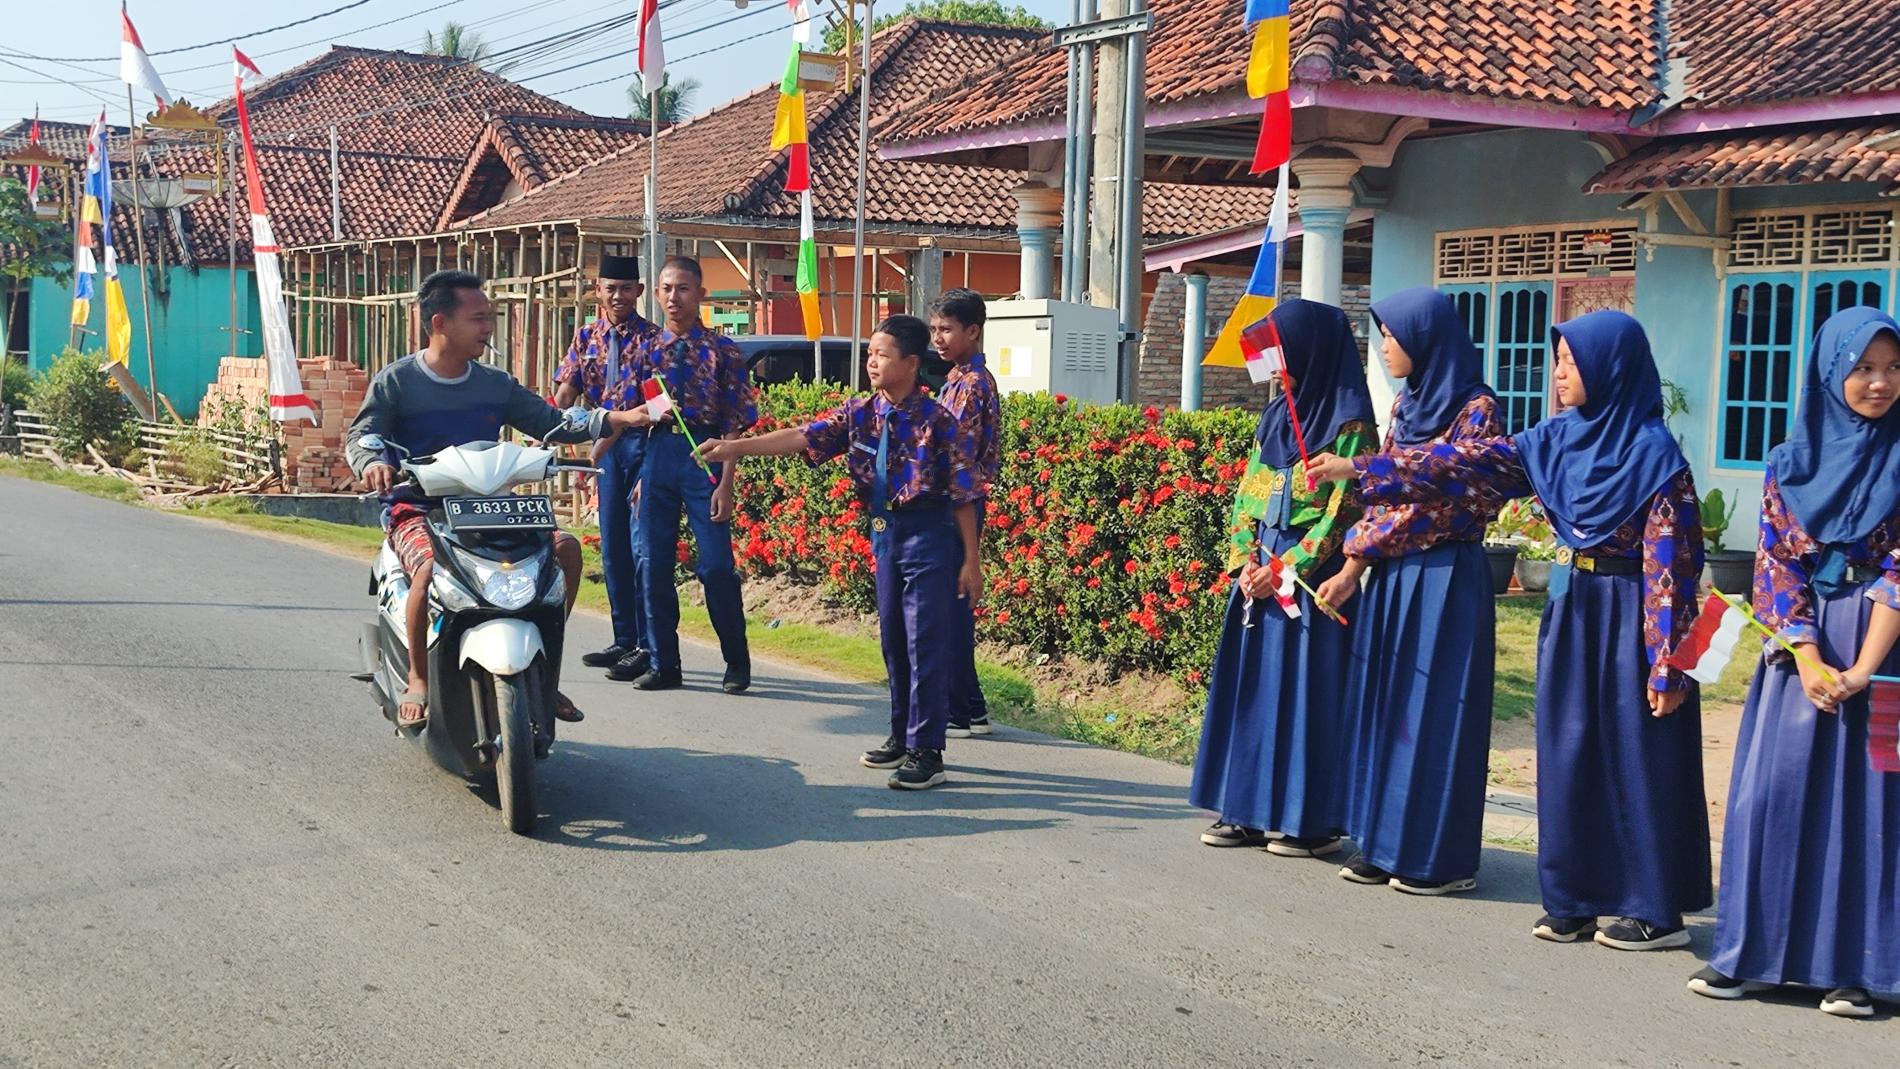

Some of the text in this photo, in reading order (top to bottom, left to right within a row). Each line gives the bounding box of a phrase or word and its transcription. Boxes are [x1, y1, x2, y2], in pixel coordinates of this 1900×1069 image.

[451, 500, 546, 515] B 3633 PCK
